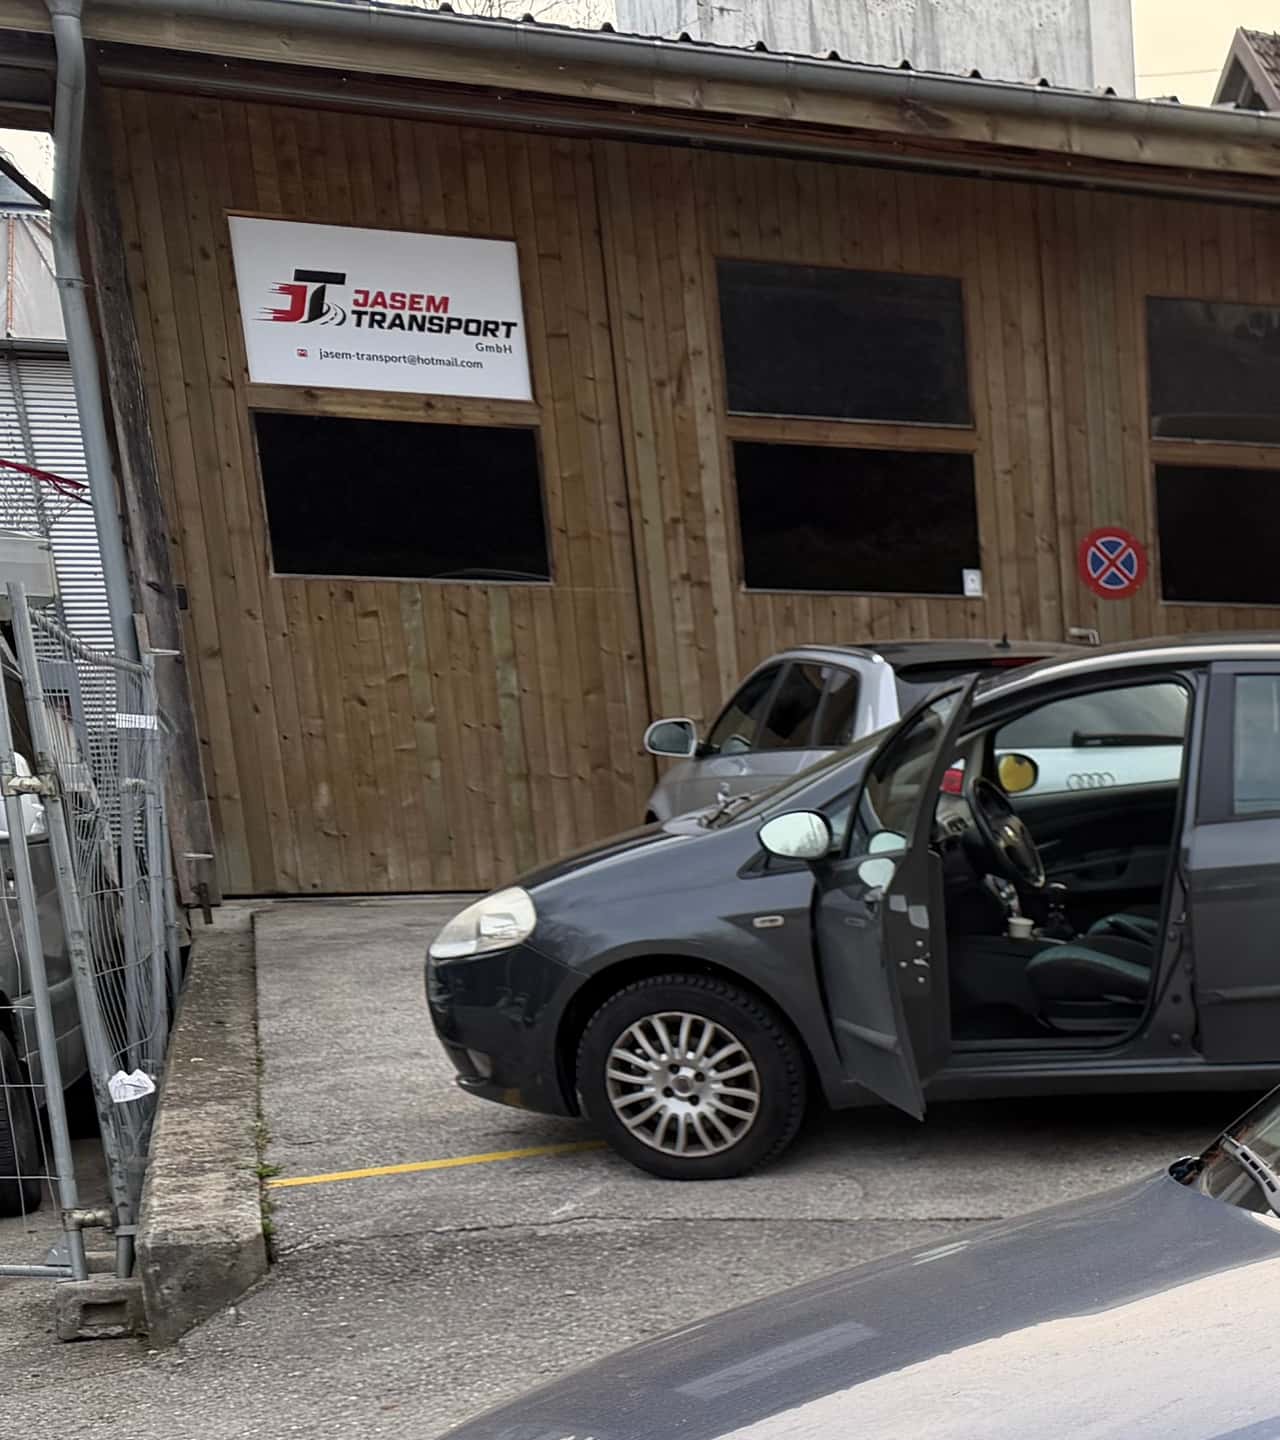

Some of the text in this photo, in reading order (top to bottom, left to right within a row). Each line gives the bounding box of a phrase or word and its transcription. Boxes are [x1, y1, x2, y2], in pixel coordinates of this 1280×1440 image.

[353, 289, 450, 314] JASEM
[351, 310, 518, 339] TRANSPORT
[319, 348, 483, 369] jasem-transport@hotmail.com
[475, 342, 513, 354] GmbH
